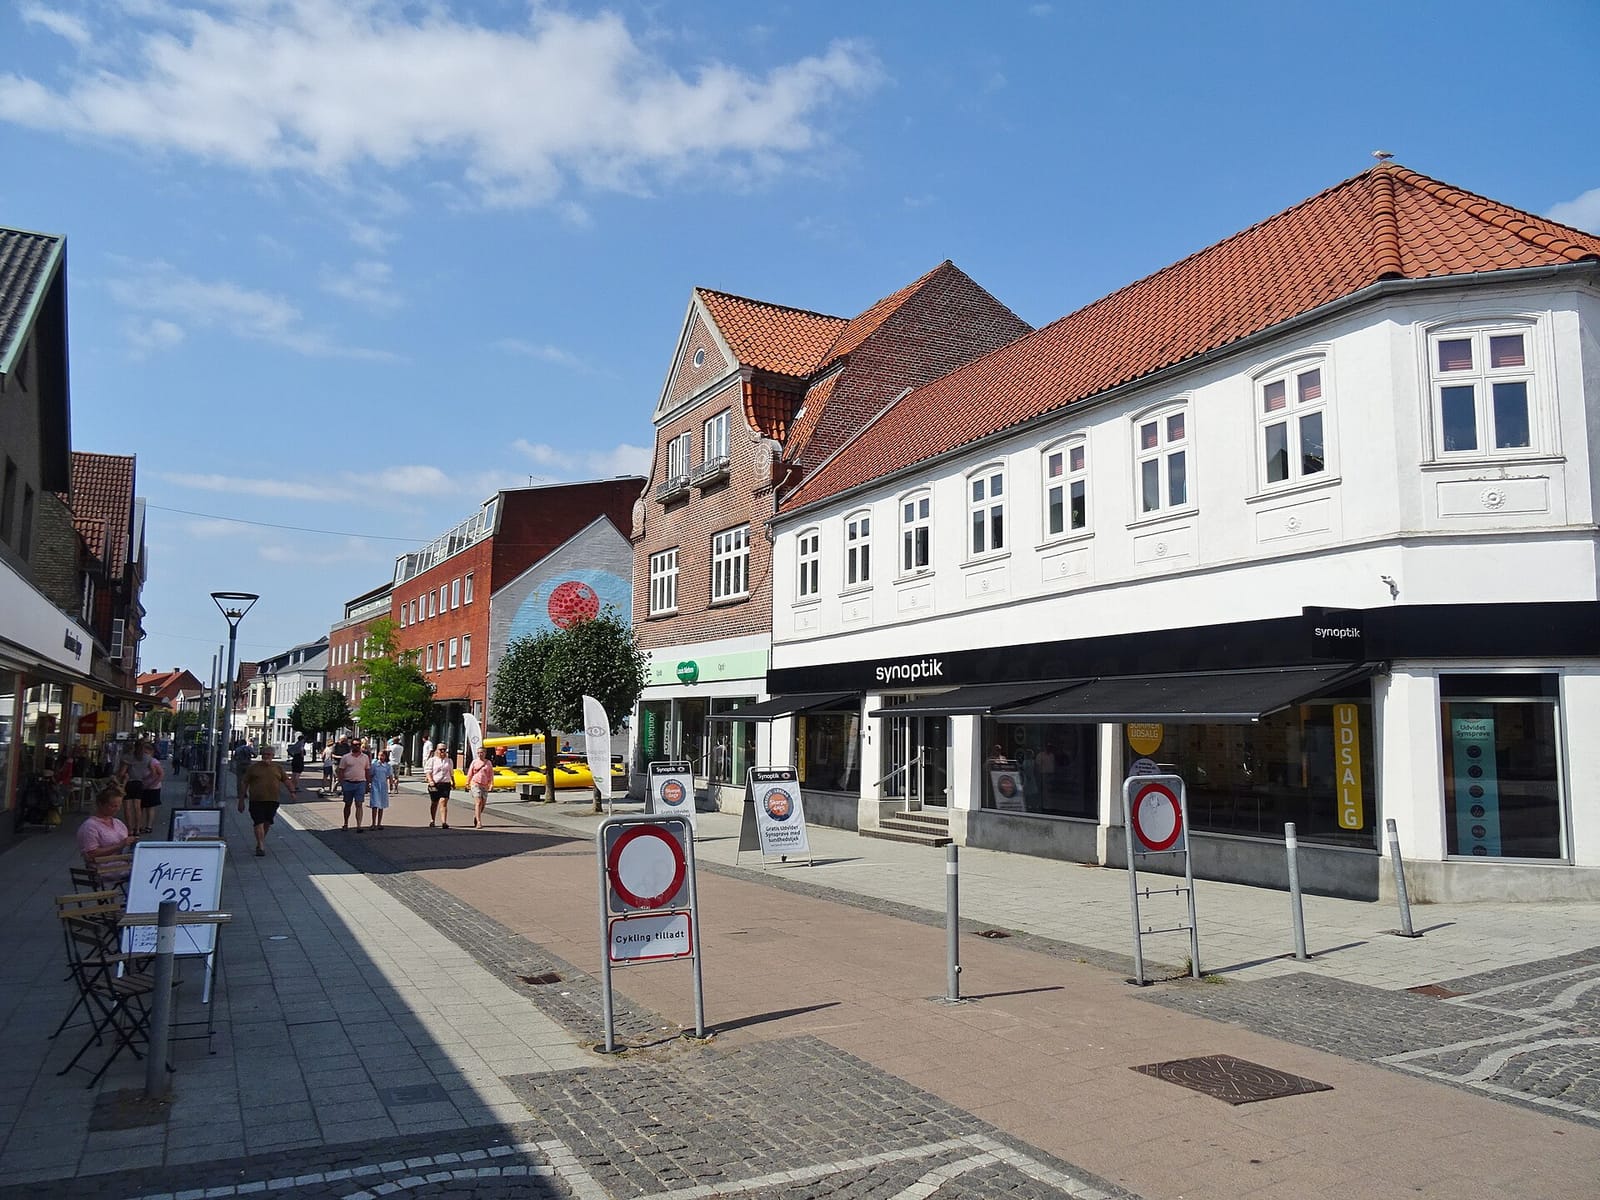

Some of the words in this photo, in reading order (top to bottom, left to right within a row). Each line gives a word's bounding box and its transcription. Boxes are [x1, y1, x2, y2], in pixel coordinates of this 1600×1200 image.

[1314, 627, 1361, 639] synoptik
[876, 658, 943, 684] synoptik
[1131, 729, 1159, 738] UDSALG
[1339, 707, 1358, 826] UDSALG
[757, 772, 780, 780] Synoptik
[148, 862, 204, 890] KAFFE
[615, 932, 651, 944] Cykling
[655, 930, 685, 940] tilladt
